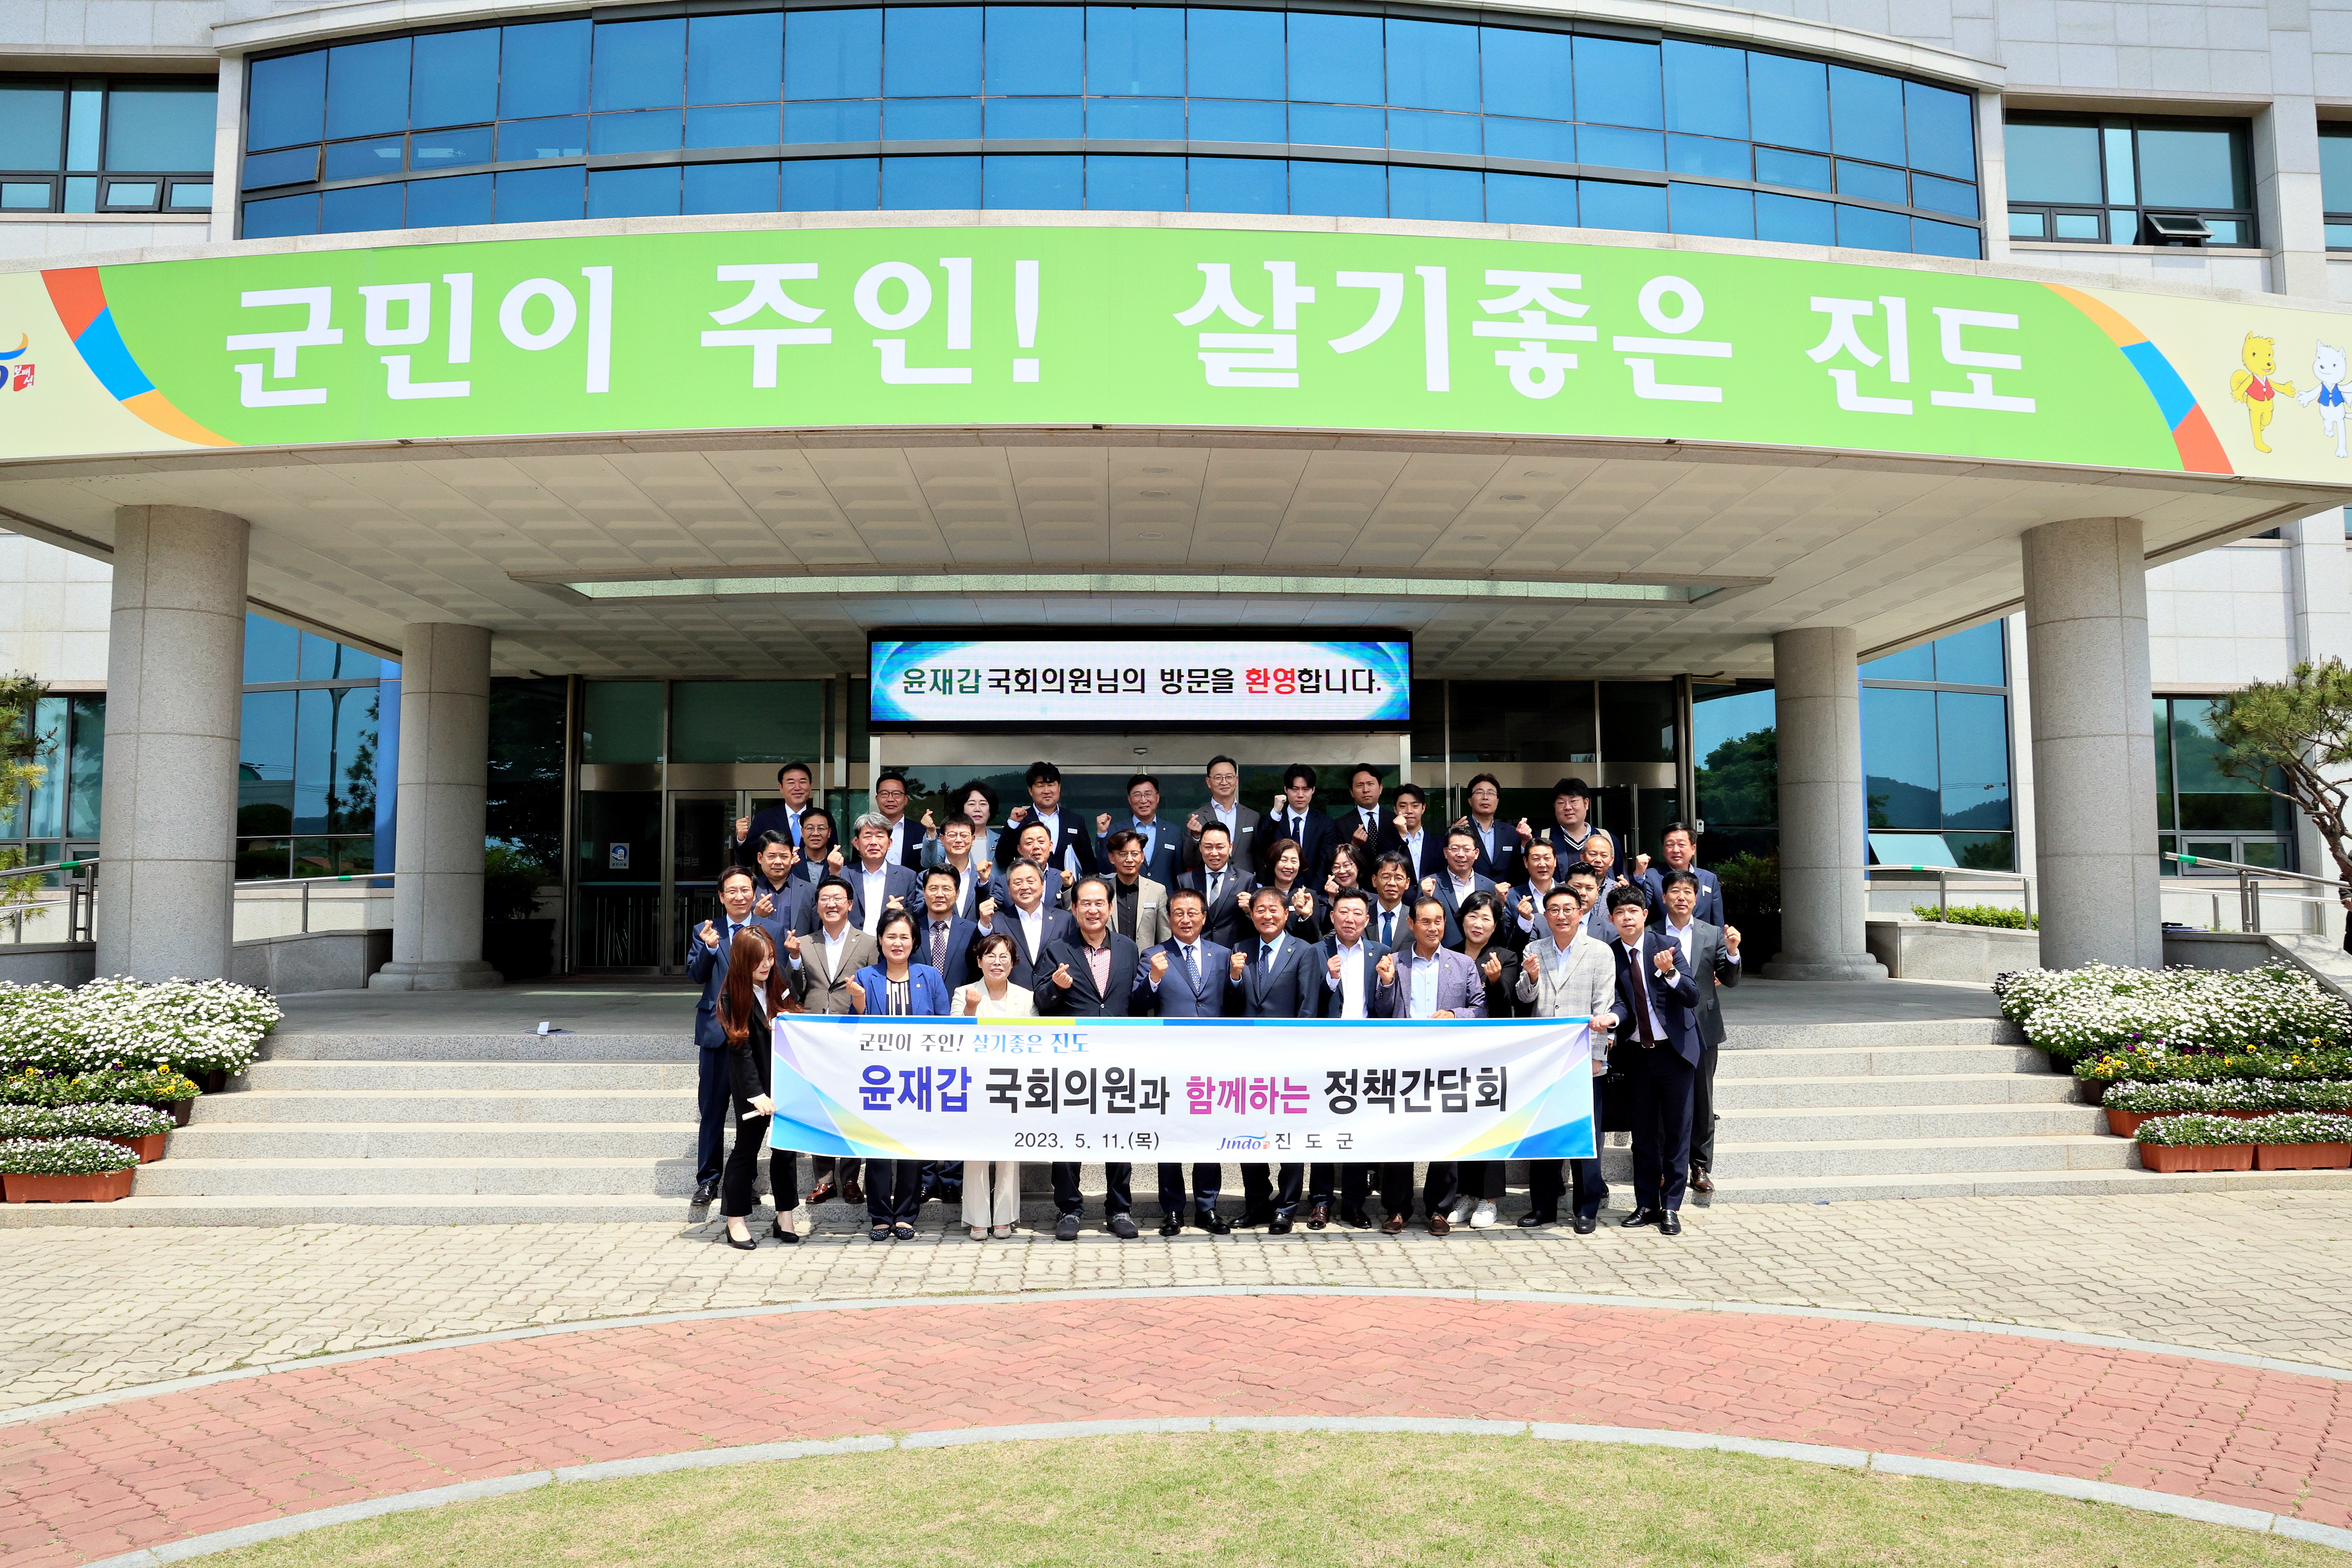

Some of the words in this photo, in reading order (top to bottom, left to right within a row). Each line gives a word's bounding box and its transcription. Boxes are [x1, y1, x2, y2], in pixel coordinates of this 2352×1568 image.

[226, 265, 613, 408] 군민이
[701, 257, 1040, 388] 주인!
[1173, 260, 1733, 403] 살기좋은
[1804, 295, 2037, 415] 진도
[902, 668, 982, 695] 윤재갑
[988, 668, 1145, 694] 국회의원님의
[1161, 668, 1234, 695] 방문을
[1245, 668, 1382, 695] 환영합니다.
[859, 1033, 911, 1051] 군민이
[920, 1034, 964, 1052] 주인!
[972, 1034, 1043, 1053] 살기좋은
[1051, 1033, 1089, 1053] 진도
[859, 1065, 972, 1112] 윤재갑
[986, 1067, 1170, 1115] 국회의원과
[1186, 1076, 1310, 1115] 함께하는
[1323, 1066, 1508, 1114] 정책간담회
[1014, 1132, 1063, 1149] 2023.
[1075, 1134, 1091, 1149] 5.
[1103, 1132, 1159, 1151] 11.(목)
